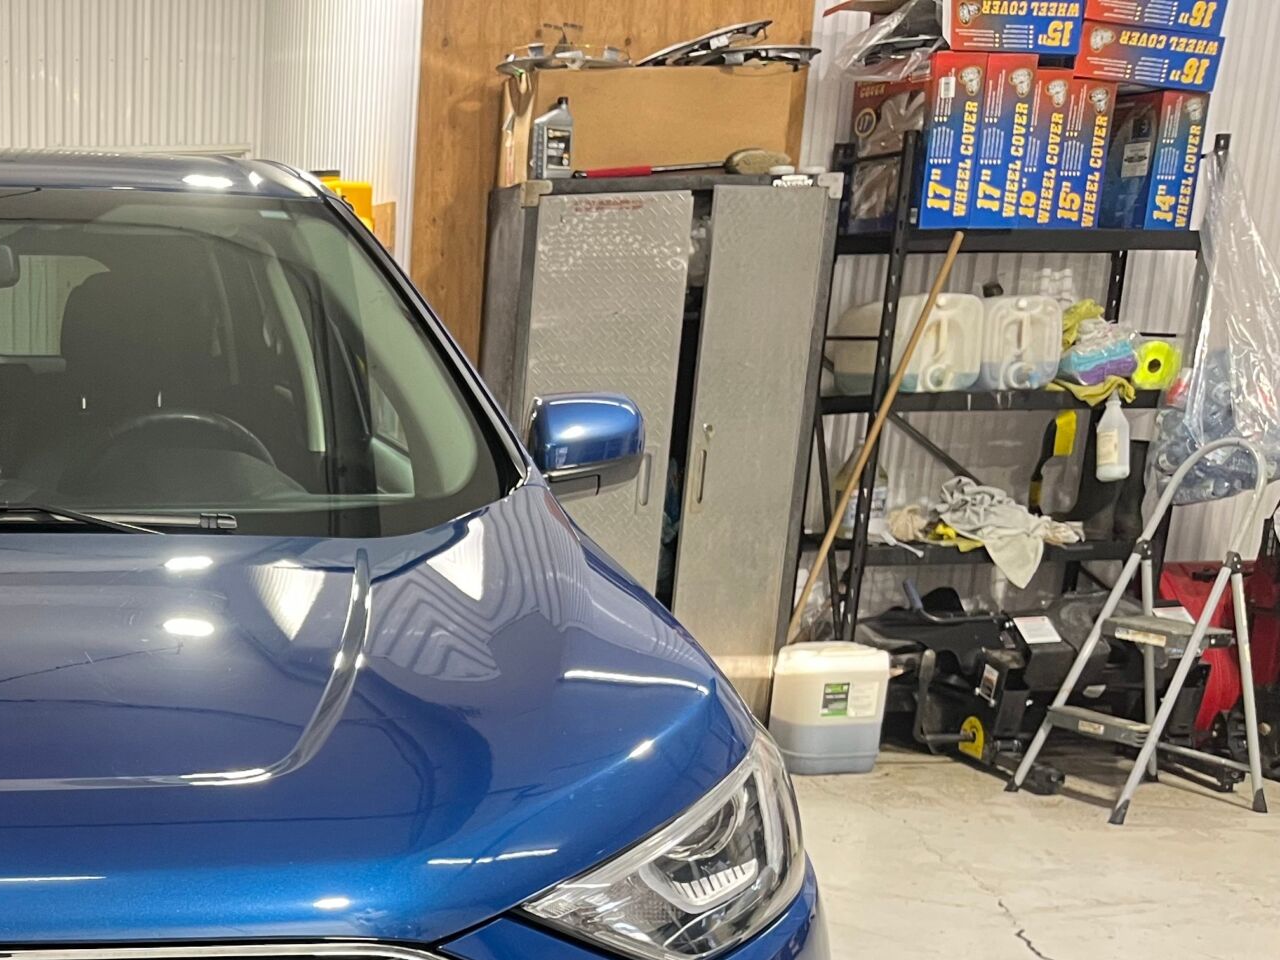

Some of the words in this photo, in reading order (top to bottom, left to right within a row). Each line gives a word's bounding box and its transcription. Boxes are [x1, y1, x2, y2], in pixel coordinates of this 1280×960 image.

[981, 0, 1027, 15] COVER
[1031, 2, 1080, 17] WHEEL
[1037, 20, 1074, 47] 15"
[1119, 30, 1168, 49] COVER
[1169, 36, 1219, 56] WHEEL
[1169, 57, 1210, 84] 16"
[960, 100, 978, 156] COVER
[1010, 102, 1029, 157] COVER
[1045, 112, 1064, 166] COVER
[1089, 114, 1108, 169] COVER
[1183, 124, 1202, 174] COVER
[927, 168, 952, 212] 17"
[953, 159, 972, 217] WHEEL
[977, 168, 1002, 212] 17"
[1002, 160, 1022, 218] WHEEL
[1037, 168, 1056, 224] WHEEL
[1057, 181, 1081, 222] 15"
[1081, 171, 1100, 227] WHEEL
[1153, 184, 1176, 222] 14"
[1175, 176, 1193, 228] WHEEL
